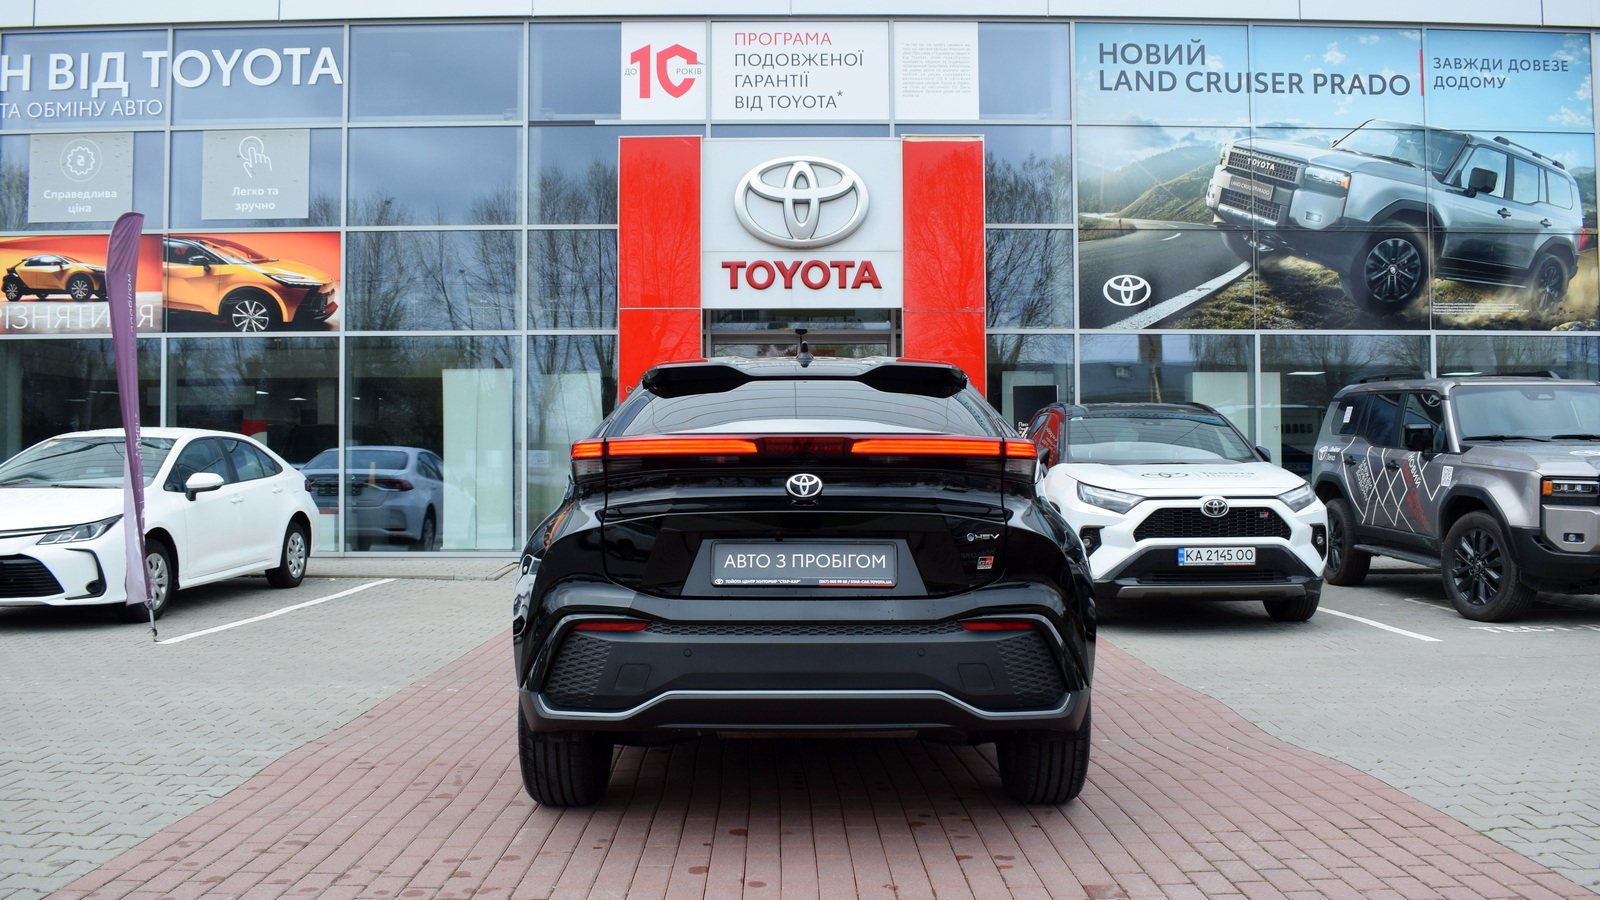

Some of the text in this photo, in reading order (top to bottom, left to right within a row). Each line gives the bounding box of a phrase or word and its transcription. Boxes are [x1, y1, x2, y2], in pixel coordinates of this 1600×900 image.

[734, 32, 832, 46] ПРОГРАМА
[734, 50, 864, 69] ПОДОВЖЕНОЇ
[1098, 39, 1206, 66] НОВИЙ
[48, 52, 129, 98] ВІД
[142, 47, 343, 88] TOYOTA
[624, 68, 702, 77] ДО РОКІВ
[1432, 56, 1569, 76] ЗАВЖДИ ДОВЕЗЕ
[734, 71, 809, 88] ГАРАНТІЇ
[1098, 70, 1411, 96] LAND CRUISER PRADO
[1433, 75, 1507, 90] ДОДОМУ
[0, 99, 163, 118] ТА ОБМІНУ АВТО
[734, 95, 763, 111] ВІД
[1247, 158, 1275, 170] TOYOTA
[43, 189, 117, 201] Справедлива
[232, 186, 264, 197] Легко
[68, 203, 92, 214] ціна
[235, 202, 276, 212] зручно
[721, 260, 882, 289] TOYOTA
[724, 554, 886, 569] АВТО З ПРОБІГОМ
[1206, 549, 1233, 561] 2145
